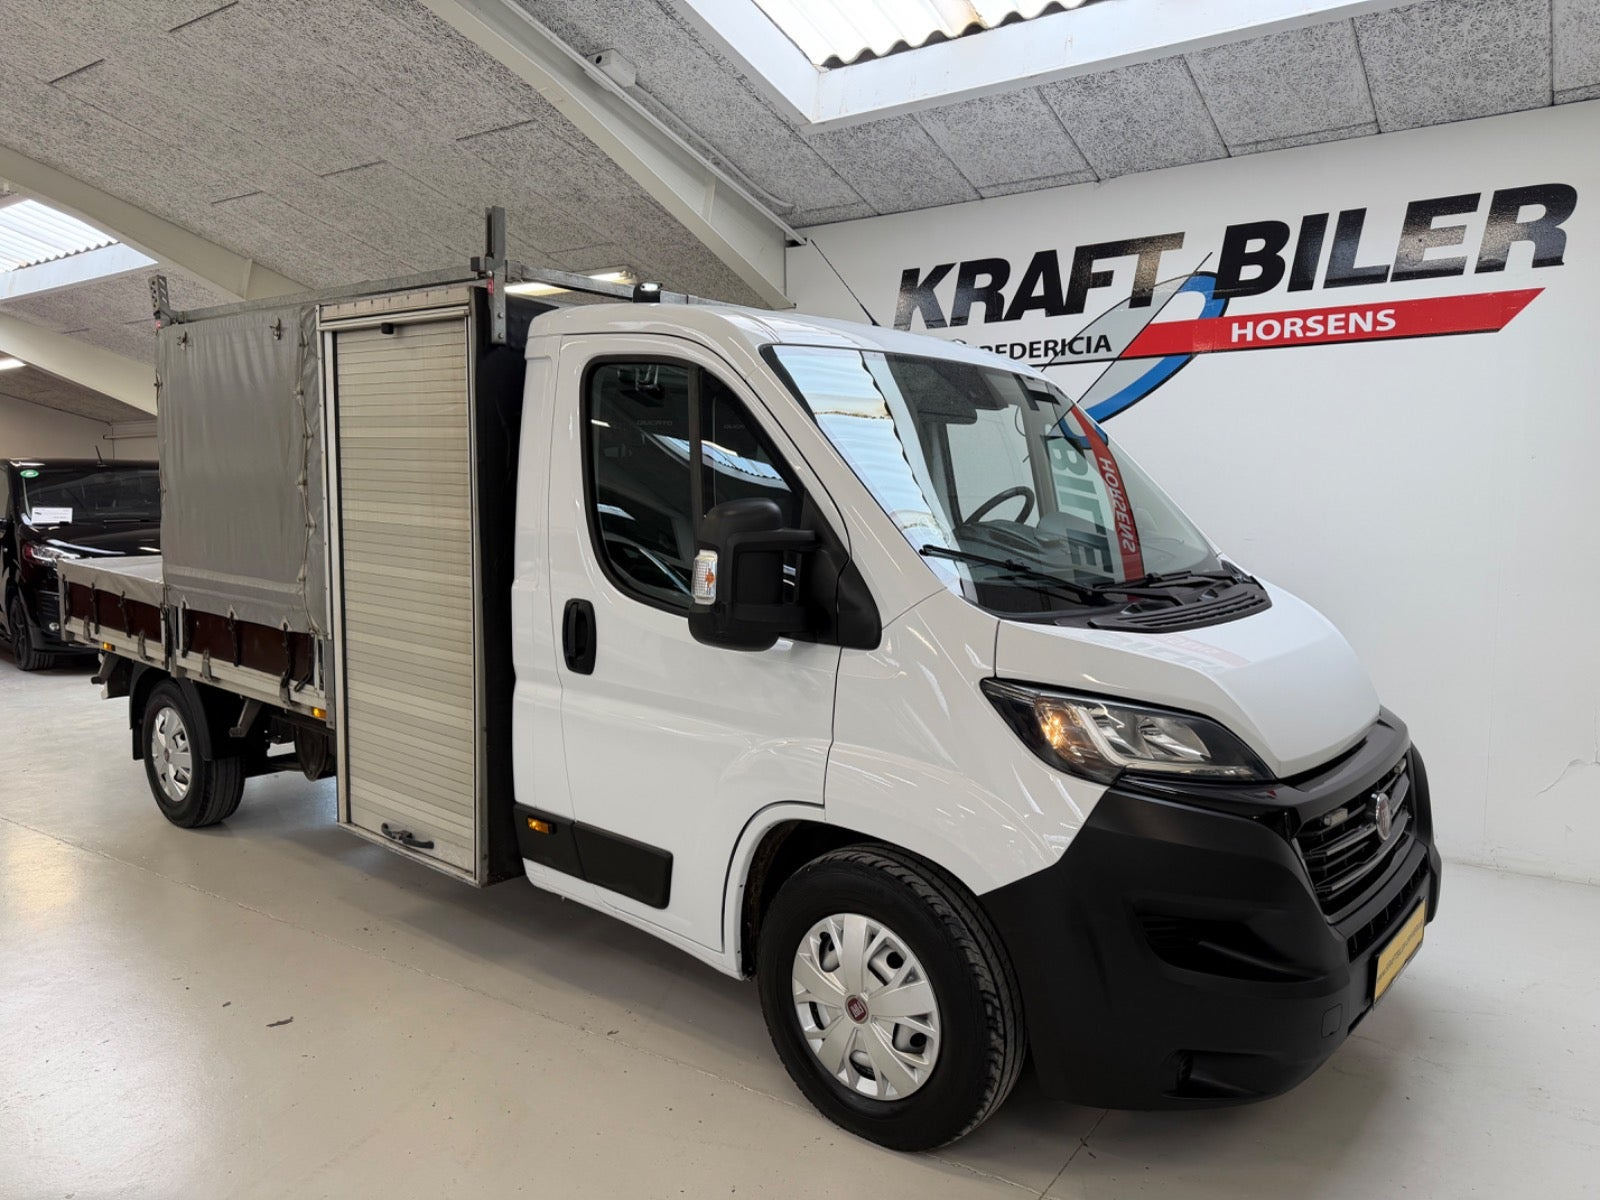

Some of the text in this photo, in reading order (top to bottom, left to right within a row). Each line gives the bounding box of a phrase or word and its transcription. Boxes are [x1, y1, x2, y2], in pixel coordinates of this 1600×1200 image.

[893, 183, 1578, 330] KRAFT BILER
[1231, 309, 1396, 343] HORSENS
[976, 334, 1112, 360] EDERICIA
